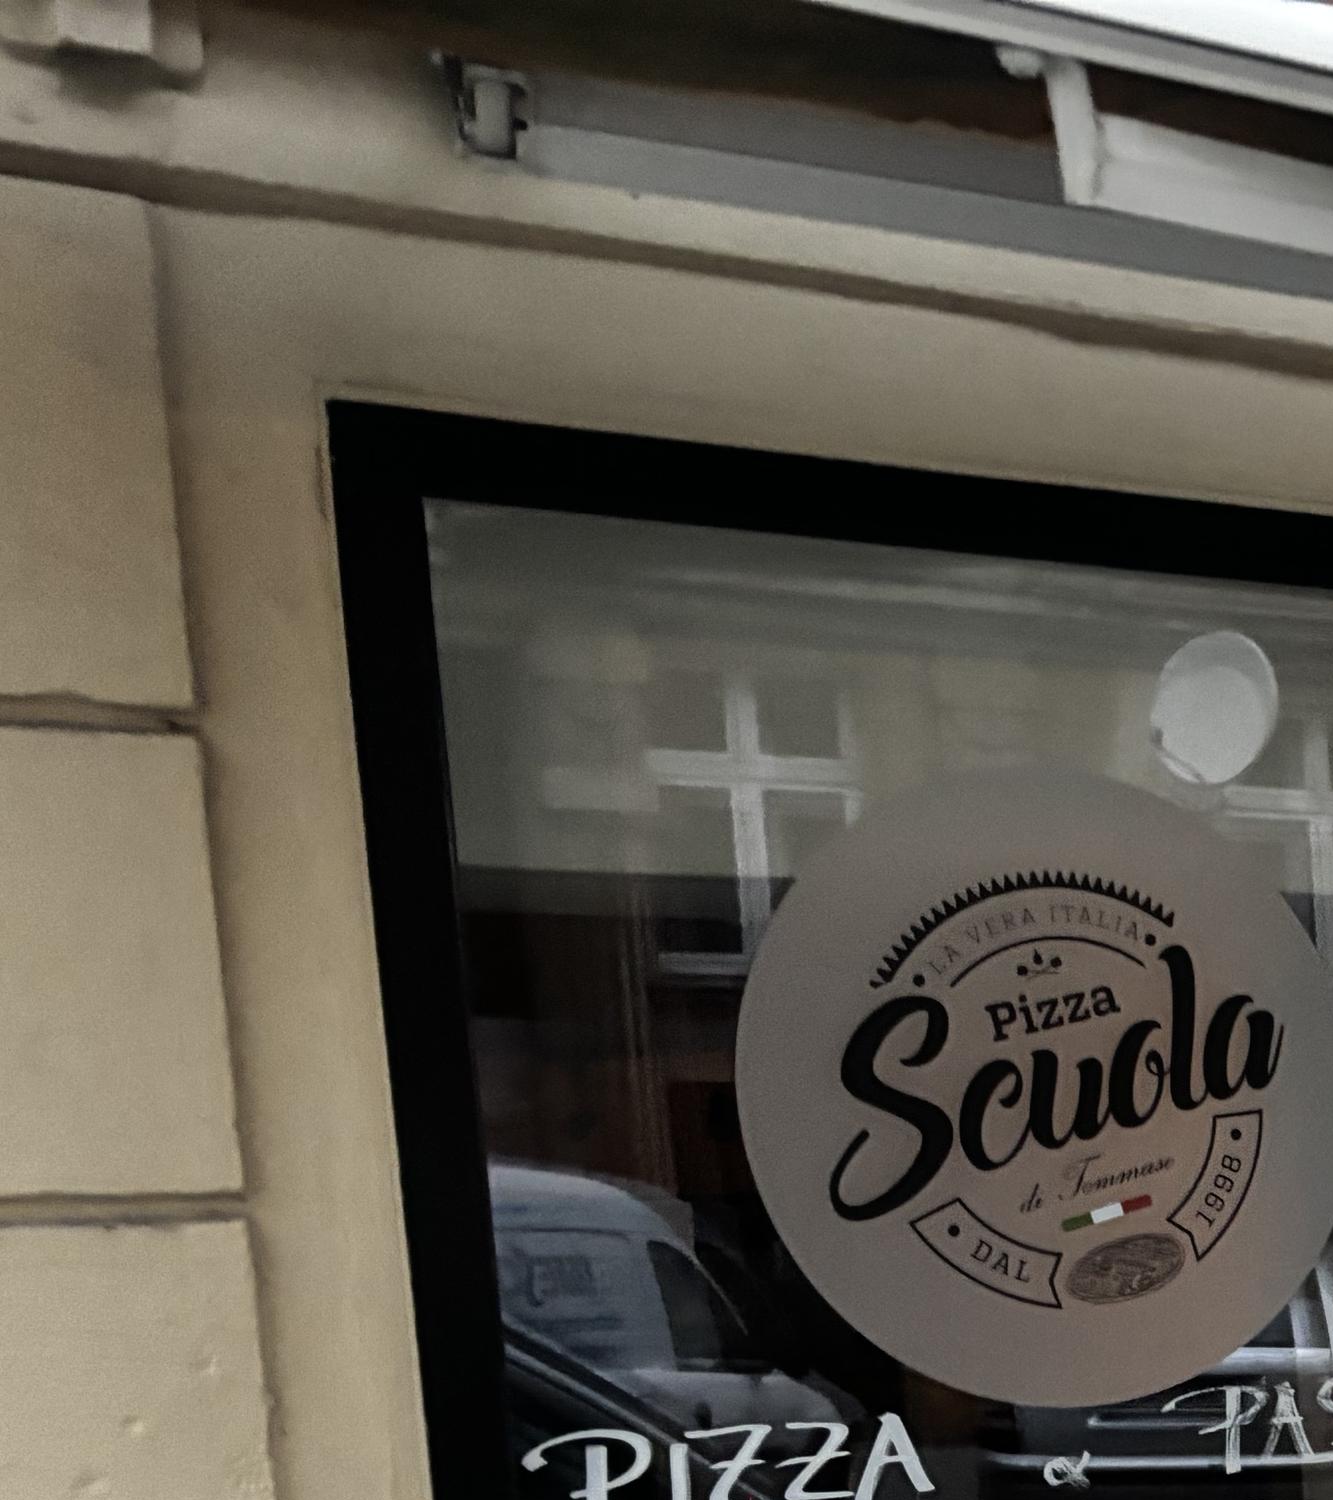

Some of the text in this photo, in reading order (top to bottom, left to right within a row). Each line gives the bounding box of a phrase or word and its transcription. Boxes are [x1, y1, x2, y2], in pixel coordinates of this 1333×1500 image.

[985, 984, 1120, 1043] Pizza
[829, 945, 1284, 1221] Scuola
[1195, 1154, 1242, 1227] 1998
[972, 1239, 1030, 1283] DAL
